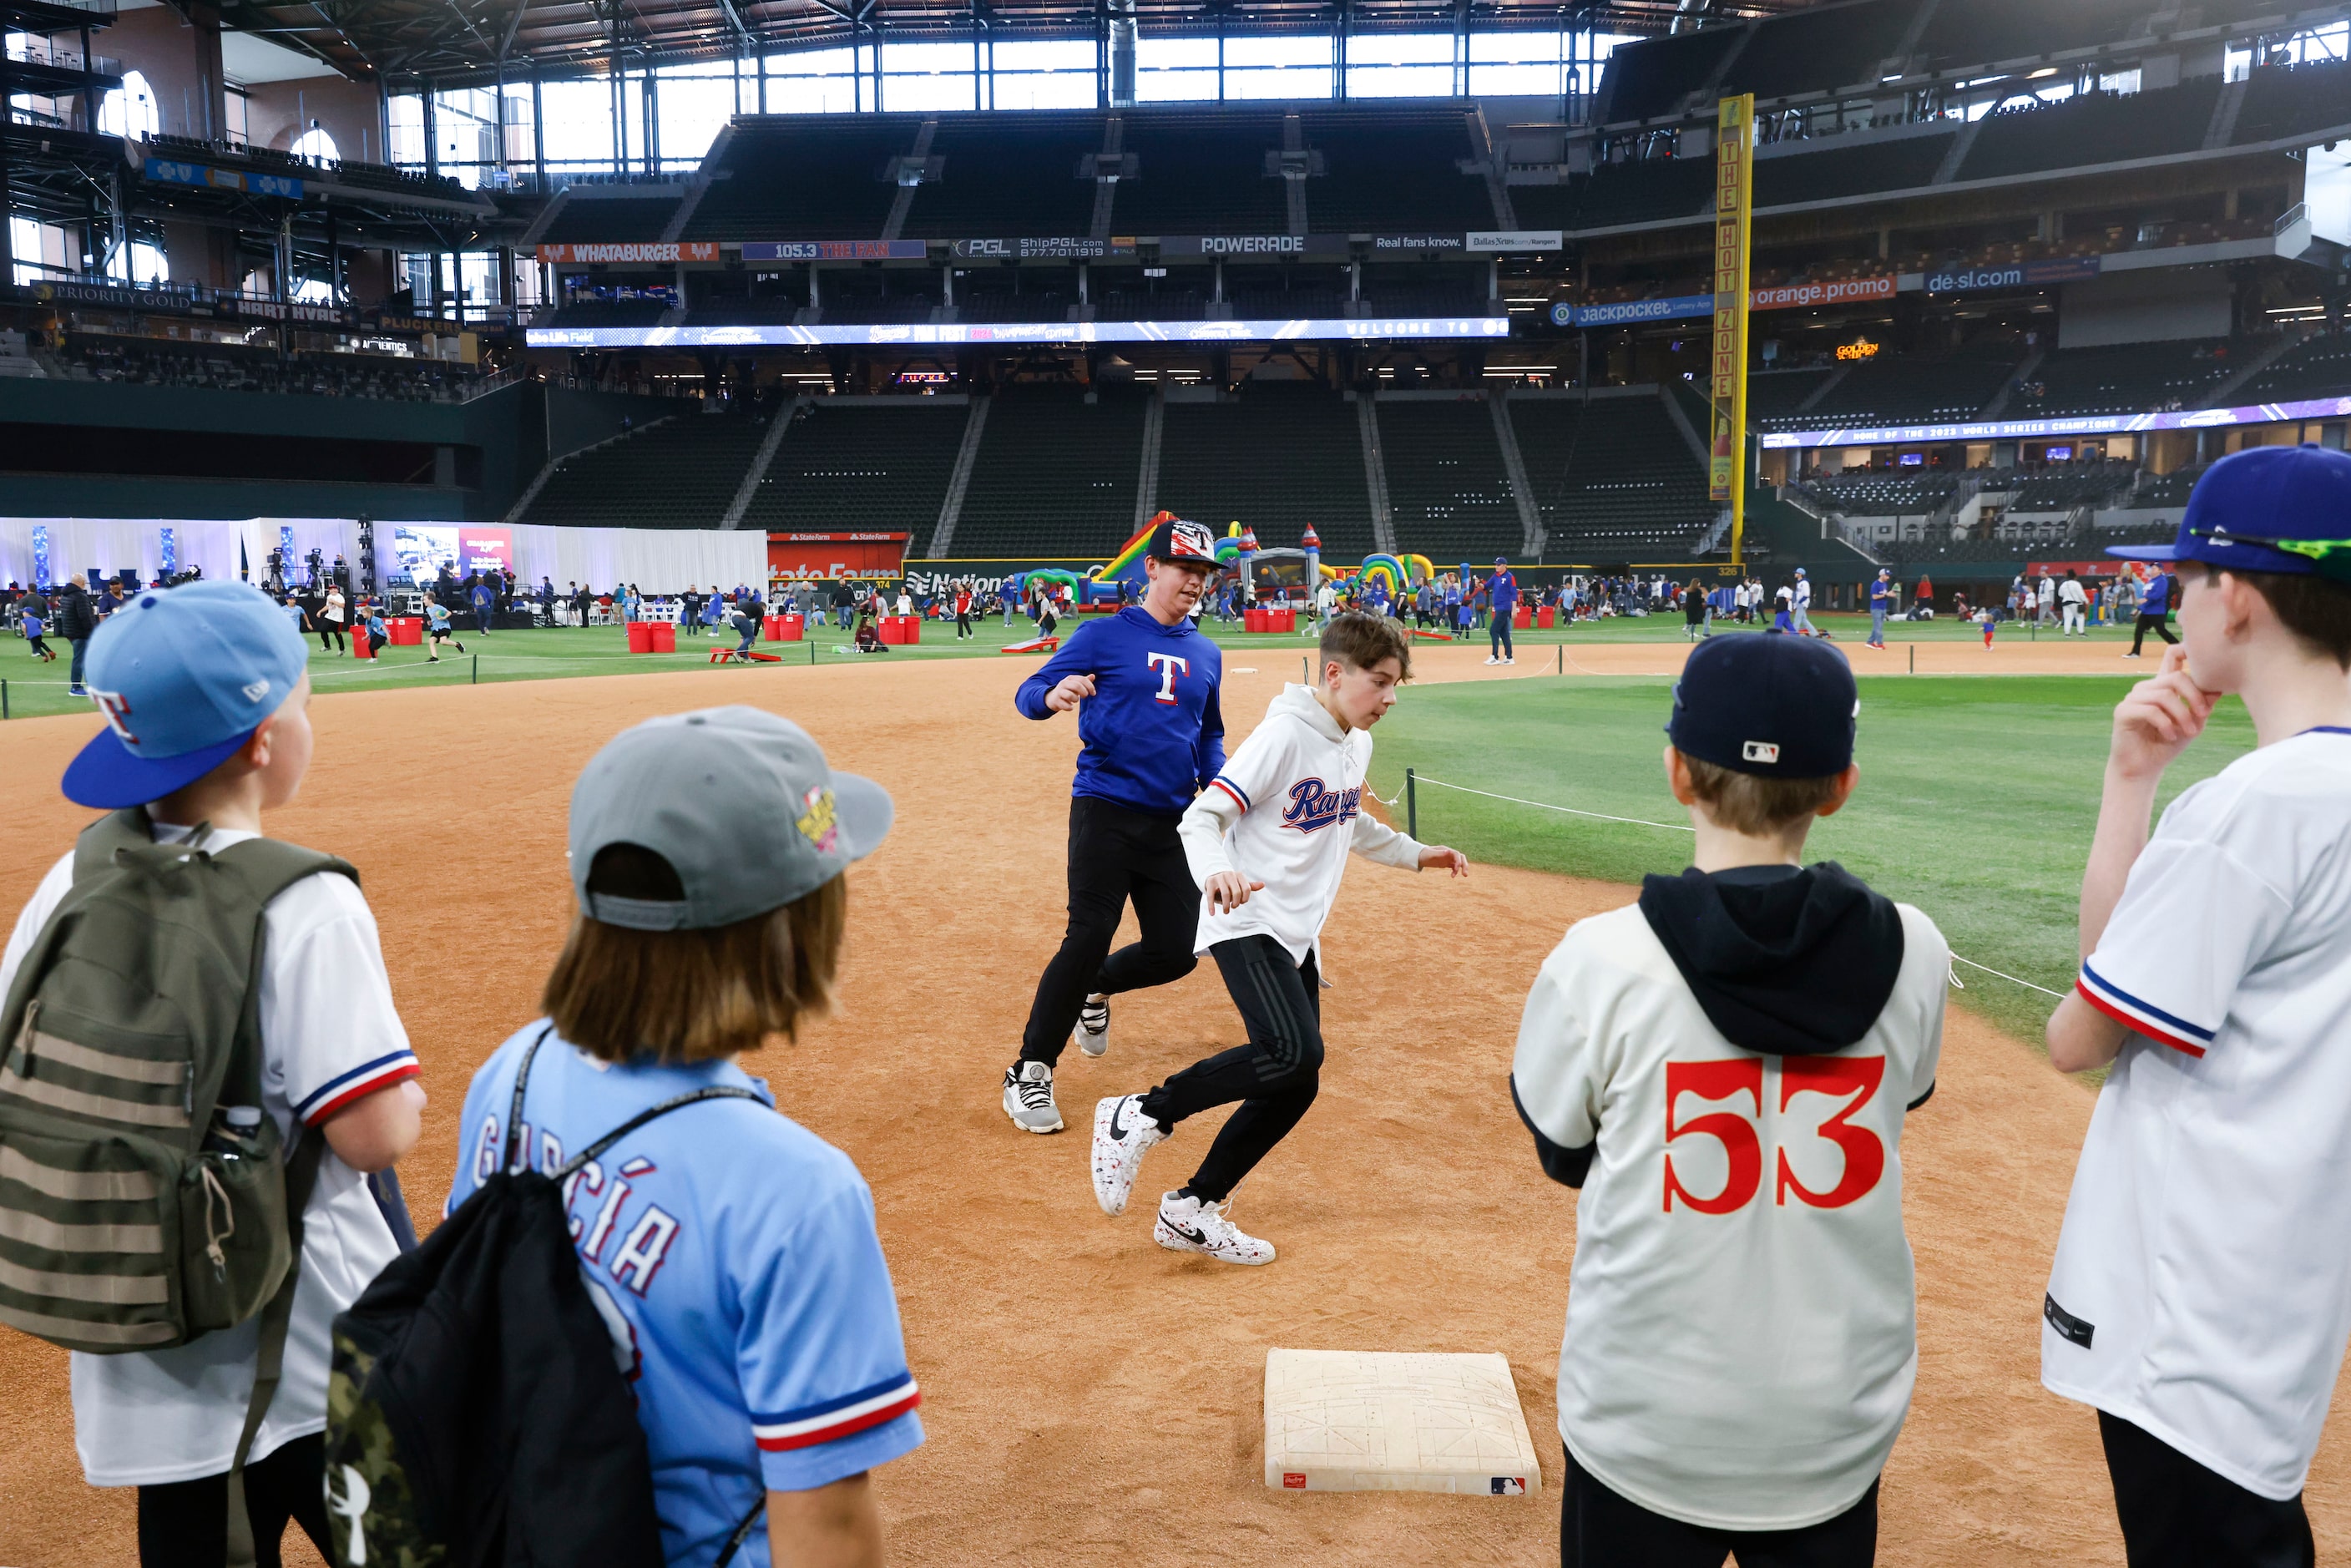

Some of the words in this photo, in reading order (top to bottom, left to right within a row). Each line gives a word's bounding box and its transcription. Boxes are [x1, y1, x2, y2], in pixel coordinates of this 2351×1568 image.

[776, 244, 817, 258] 105.3
[819, 242, 852, 257] THE
[855, 241, 890, 256] FAN
[968, 239, 1011, 254] PGL
[1020, 238, 1104, 248] ShipPGL.com
[1201, 236, 1304, 252] POWERADE
[1378, 238, 1401, 248] Real
[1403, 237, 1426, 247] fans
[1428, 236, 1461, 247] know.
[573, 244, 680, 262] WHATABURGER
[1020, 248, 1104, 257] 877.701.1919
[58, 286, 135, 305] PRIORITY
[143, 294, 190, 308] GOLD
[1757, 278, 1890, 305] orange.promo
[237, 301, 287, 320] HART
[292, 306, 341, 323] HVAC
[1672, 303, 1696, 311] Lottery
[1696, 301, 1711, 310] App
[381, 316, 463, 333] PLUCKERS
[1045, 326, 1074, 338] EDITION
[1346, 321, 1430, 333] WELCOME
[1447, 321, 1469, 332] TO
[526, 331, 549, 343] lobe
[570, 331, 594, 342] Field
[1837, 342, 1878, 354] GOLDEN
[1929, 427, 1957, 437] 2023
[1963, 426, 1997, 435] WORLD
[2004, 422, 2045, 433] SERIES
[2051, 419, 2117, 432] CHAMPIONS
[1718, 567, 1737, 577] 326
[876, 580, 891, 589] 374
[1147, 651, 1191, 706] T
[1663, 1054, 1886, 1216] 53
